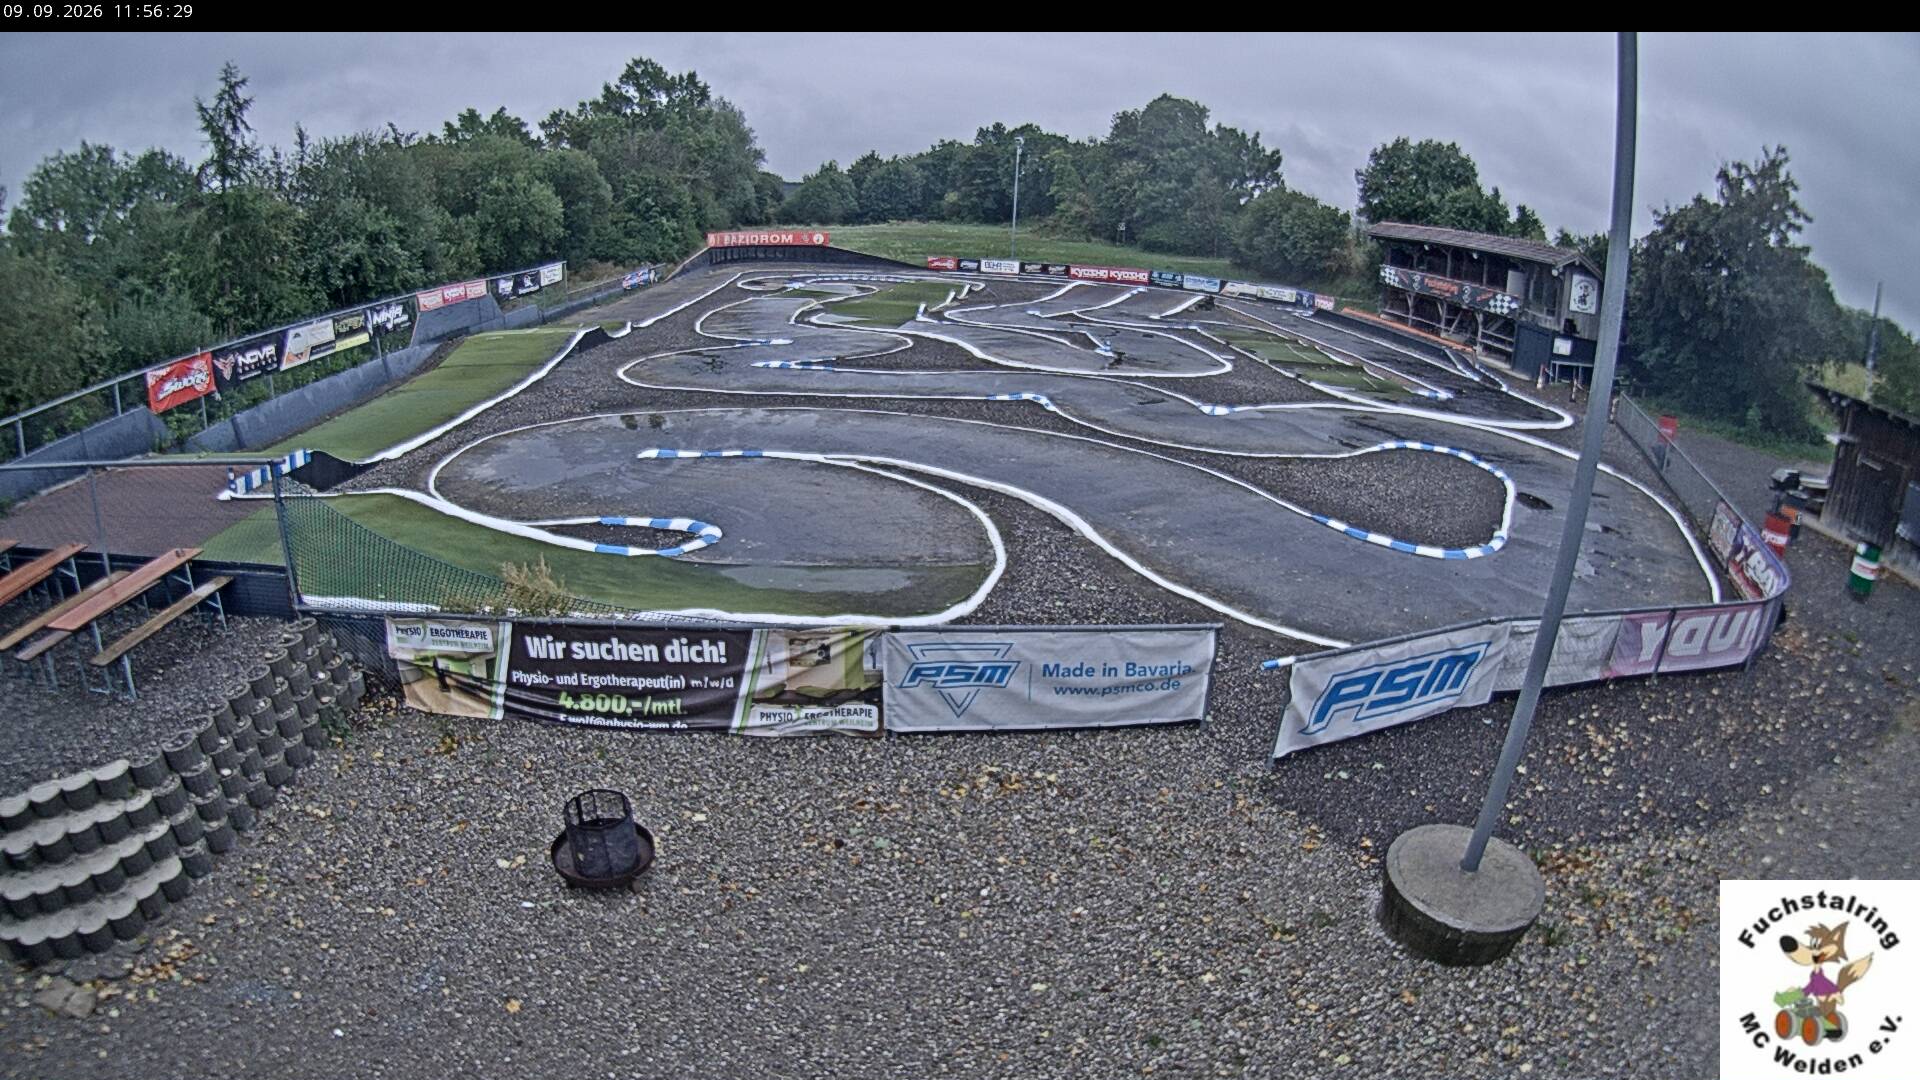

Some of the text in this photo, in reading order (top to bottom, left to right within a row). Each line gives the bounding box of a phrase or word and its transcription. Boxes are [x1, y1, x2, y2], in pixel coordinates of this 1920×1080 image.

[430, 627, 488, 640] ERGOTHERAPIE
[525, 635, 728, 664] Wir suchen dich!
[512, 670, 734, 690] Physio- und Ergotherapeut(in) m/w/d
[904, 663, 1014, 686] PSM
[1042, 663, 1095, 678] Made
[1102, 663, 1118, 678] in
[1053, 679, 1181, 698] www.psmco.de
[1308, 649, 1484, 727] PSM
[760, 711, 793, 722] PHYSIO
